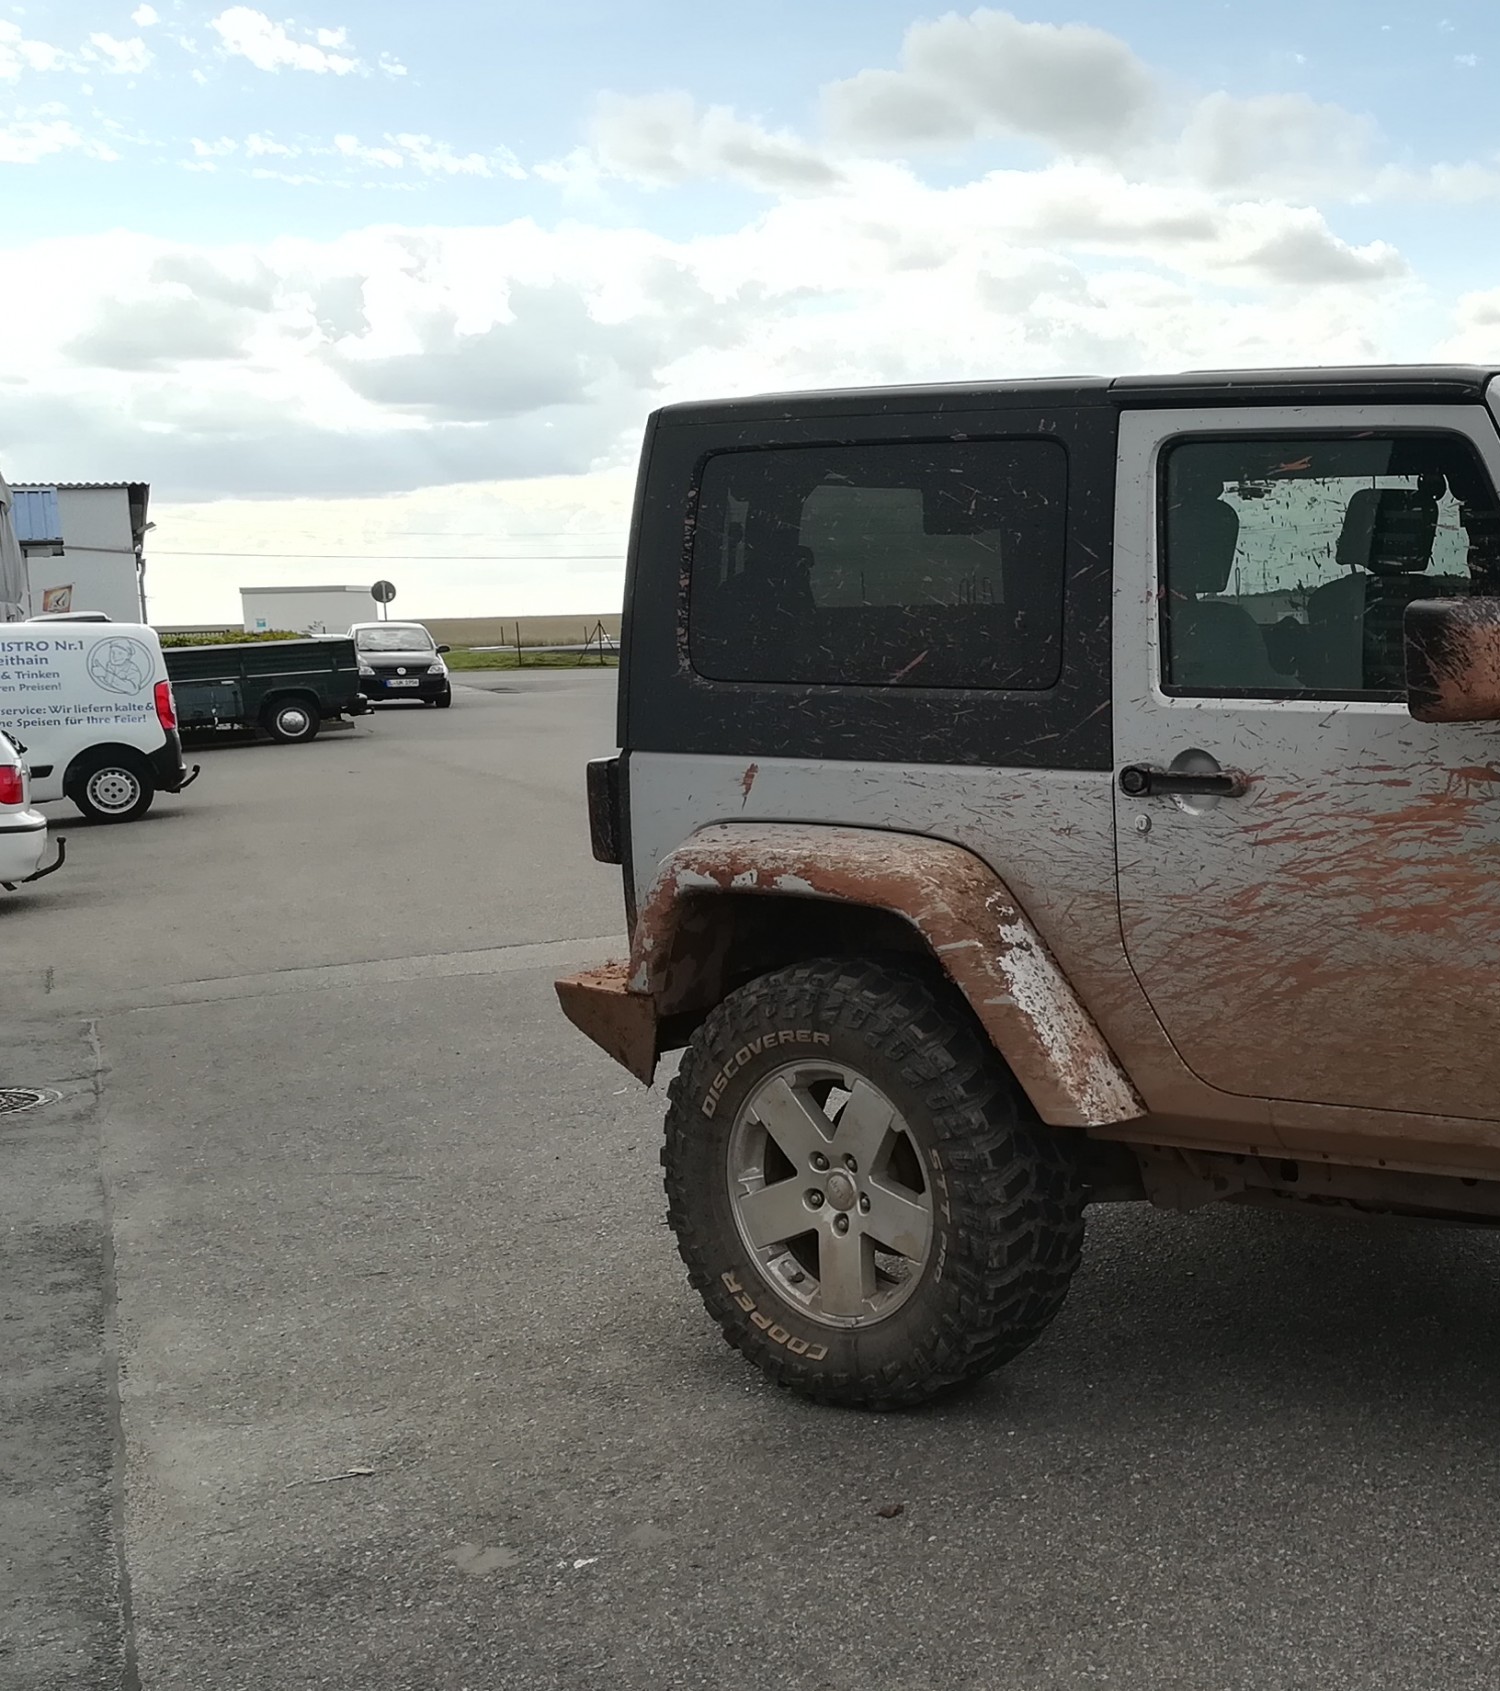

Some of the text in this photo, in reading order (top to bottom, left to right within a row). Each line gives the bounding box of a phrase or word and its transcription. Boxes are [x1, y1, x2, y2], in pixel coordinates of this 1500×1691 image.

[54, 640, 84, 651] Nr.1
[1, 670, 60, 680] & Trinken
[19, 682, 62, 692] Preisen!
[48, 704, 72, 715] Wir
[74, 703, 113, 714] liefern
[115, 702, 144, 713] kalte
[145, 702, 155, 712] &
[16, 717, 61, 730] Speisen
[65, 716, 84, 726] für
[87, 715, 111, 725] Ihre
[114, 714, 148, 724] Feier!
[701, 1029, 832, 1119] DISCOVERER
[720, 1269, 829, 1362] COOPER
